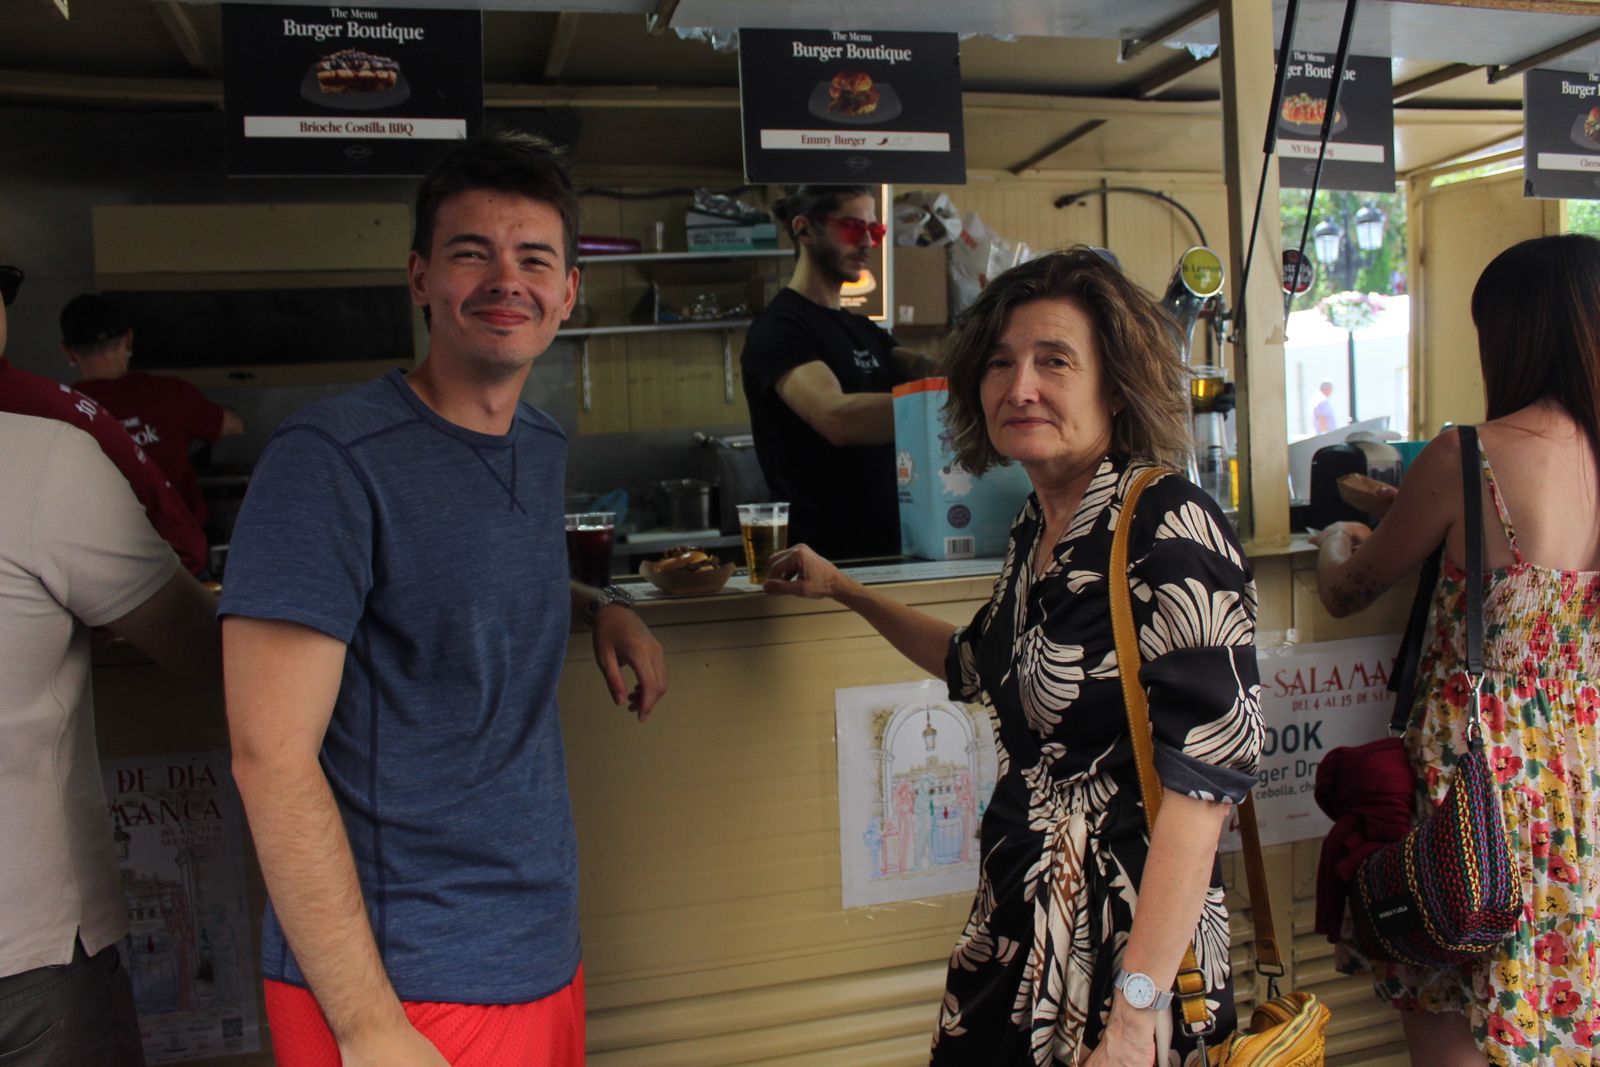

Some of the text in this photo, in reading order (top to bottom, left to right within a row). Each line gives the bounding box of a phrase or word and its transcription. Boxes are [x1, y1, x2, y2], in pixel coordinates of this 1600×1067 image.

[330, 8, 378, 19] The Menu
[283, 19, 425, 44] Burger Boutique
[832, 32, 872, 42] The Menu
[792, 41, 912, 65] Burger Boutique
[1293, 51, 1326, 63] The Menu
[1561, 81, 1596, 99] Burger
[299, 121, 414, 136] Brioche Costilla BBQ
[801, 134, 866, 147] Emmy Burger
[1274, 656, 1397, 699] SALAMA
[1292, 699, 1309, 712] DEL
[1313, 699, 1320, 711] 4
[1324, 698, 1337, 709] AL
[1341, 694, 1352, 707] 15
[1357, 693, 1370, 705] DE
[117, 757, 218, 794] DE DÍA
[1256, 784, 1297, 799] cebolla,
